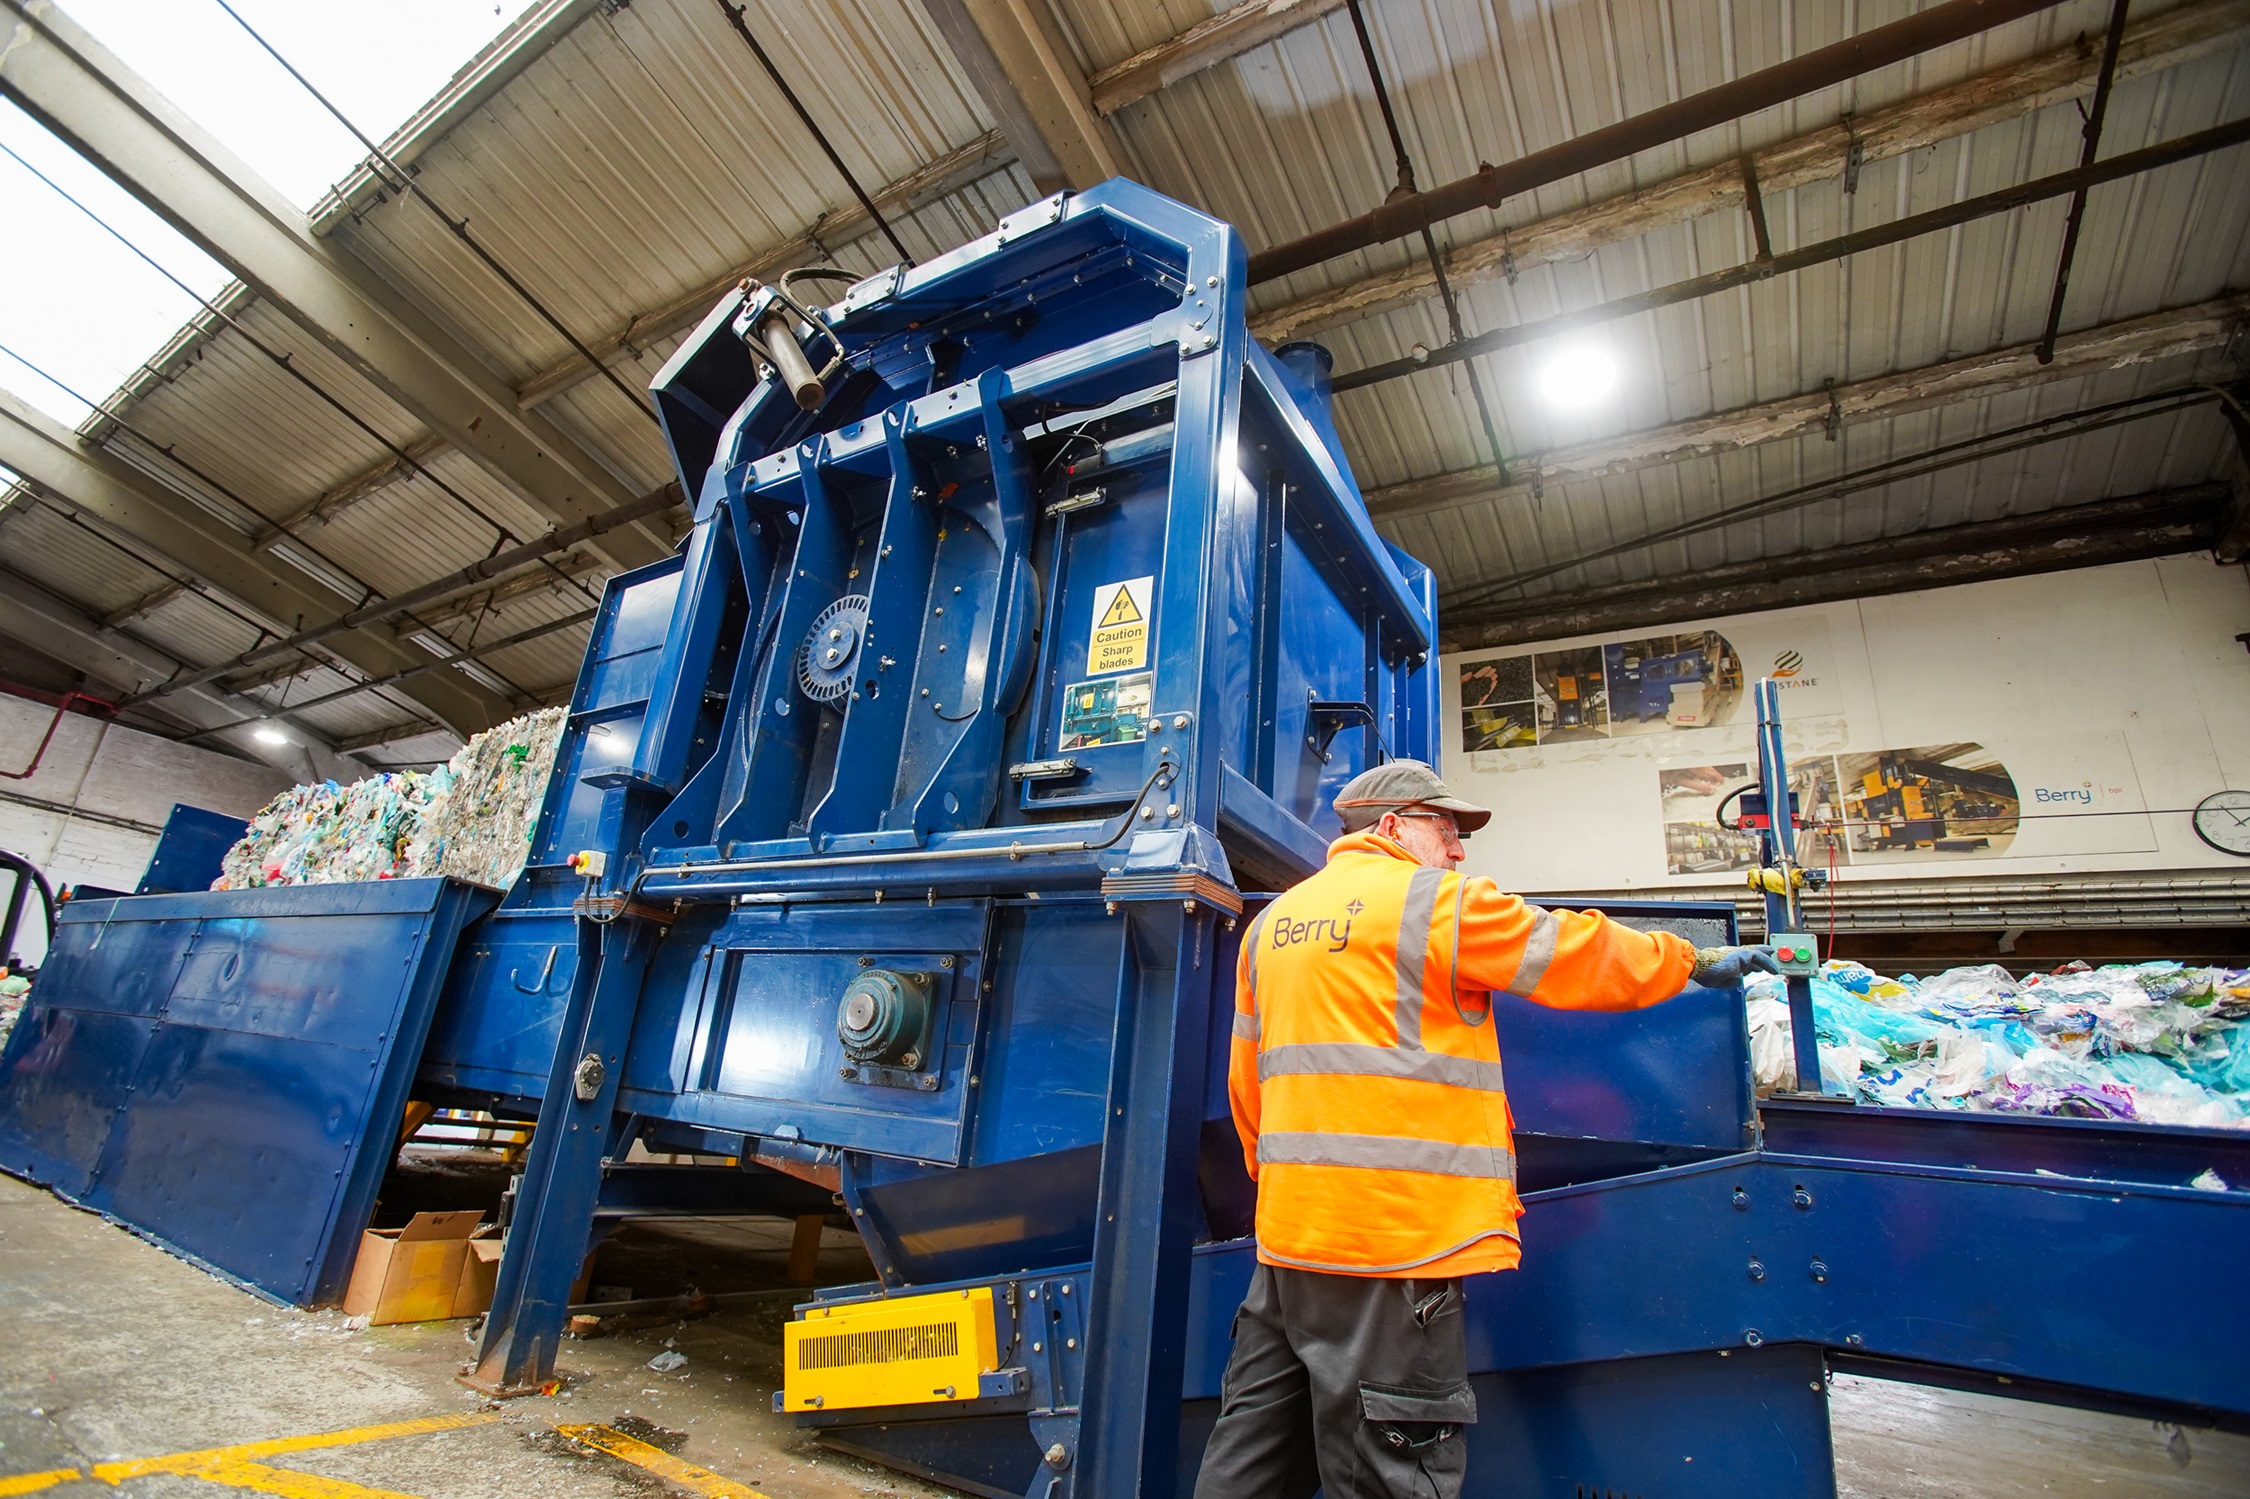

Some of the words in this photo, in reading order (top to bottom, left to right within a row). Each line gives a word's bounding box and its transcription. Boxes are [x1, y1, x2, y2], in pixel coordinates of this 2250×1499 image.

[1096, 629, 1142, 643] Caution
[1102, 646, 1133, 657] Sharp
[1099, 658, 1134, 670] blades
[1778, 678, 1818, 690] STANE
[2034, 787, 2092, 805] Berry
[1272, 917, 1351, 953] Berry
